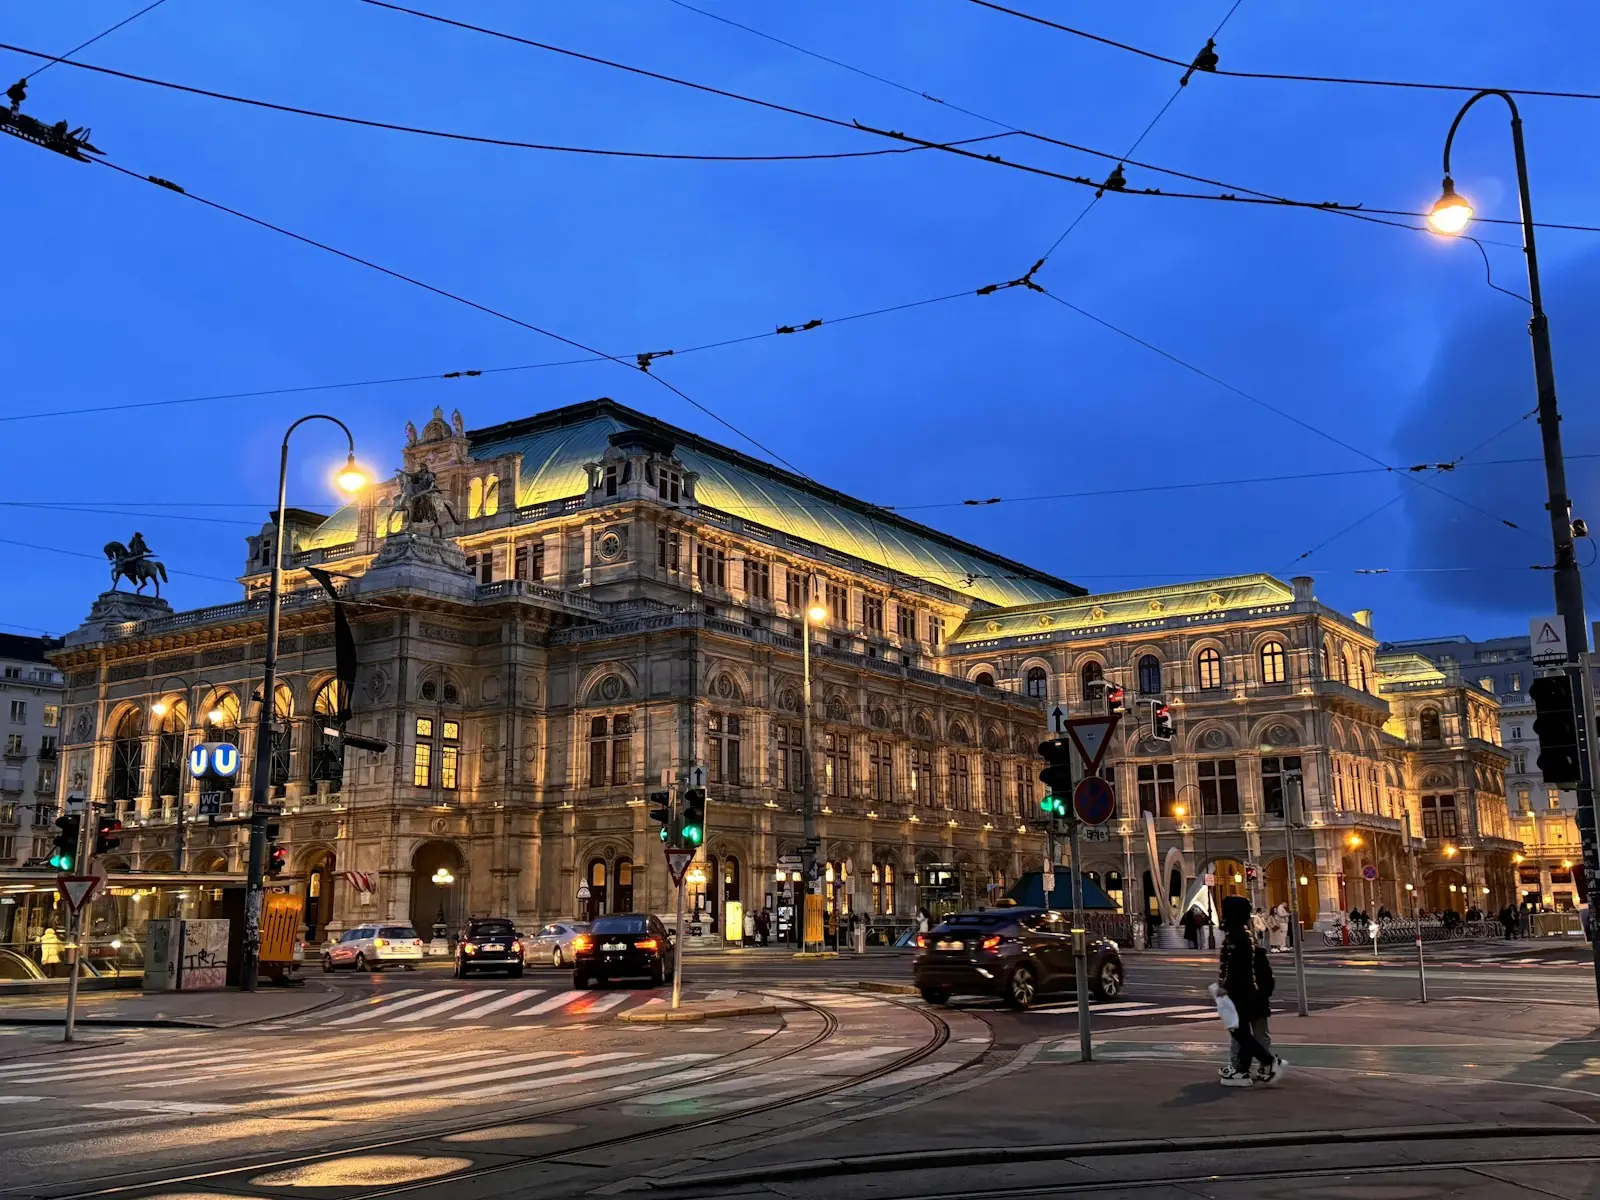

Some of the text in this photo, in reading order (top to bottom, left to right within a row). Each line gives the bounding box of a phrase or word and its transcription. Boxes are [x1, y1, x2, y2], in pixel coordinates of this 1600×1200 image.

[191, 749, 207, 774] U
[215, 749, 237, 774] U
[201, 794, 219, 804] WC
